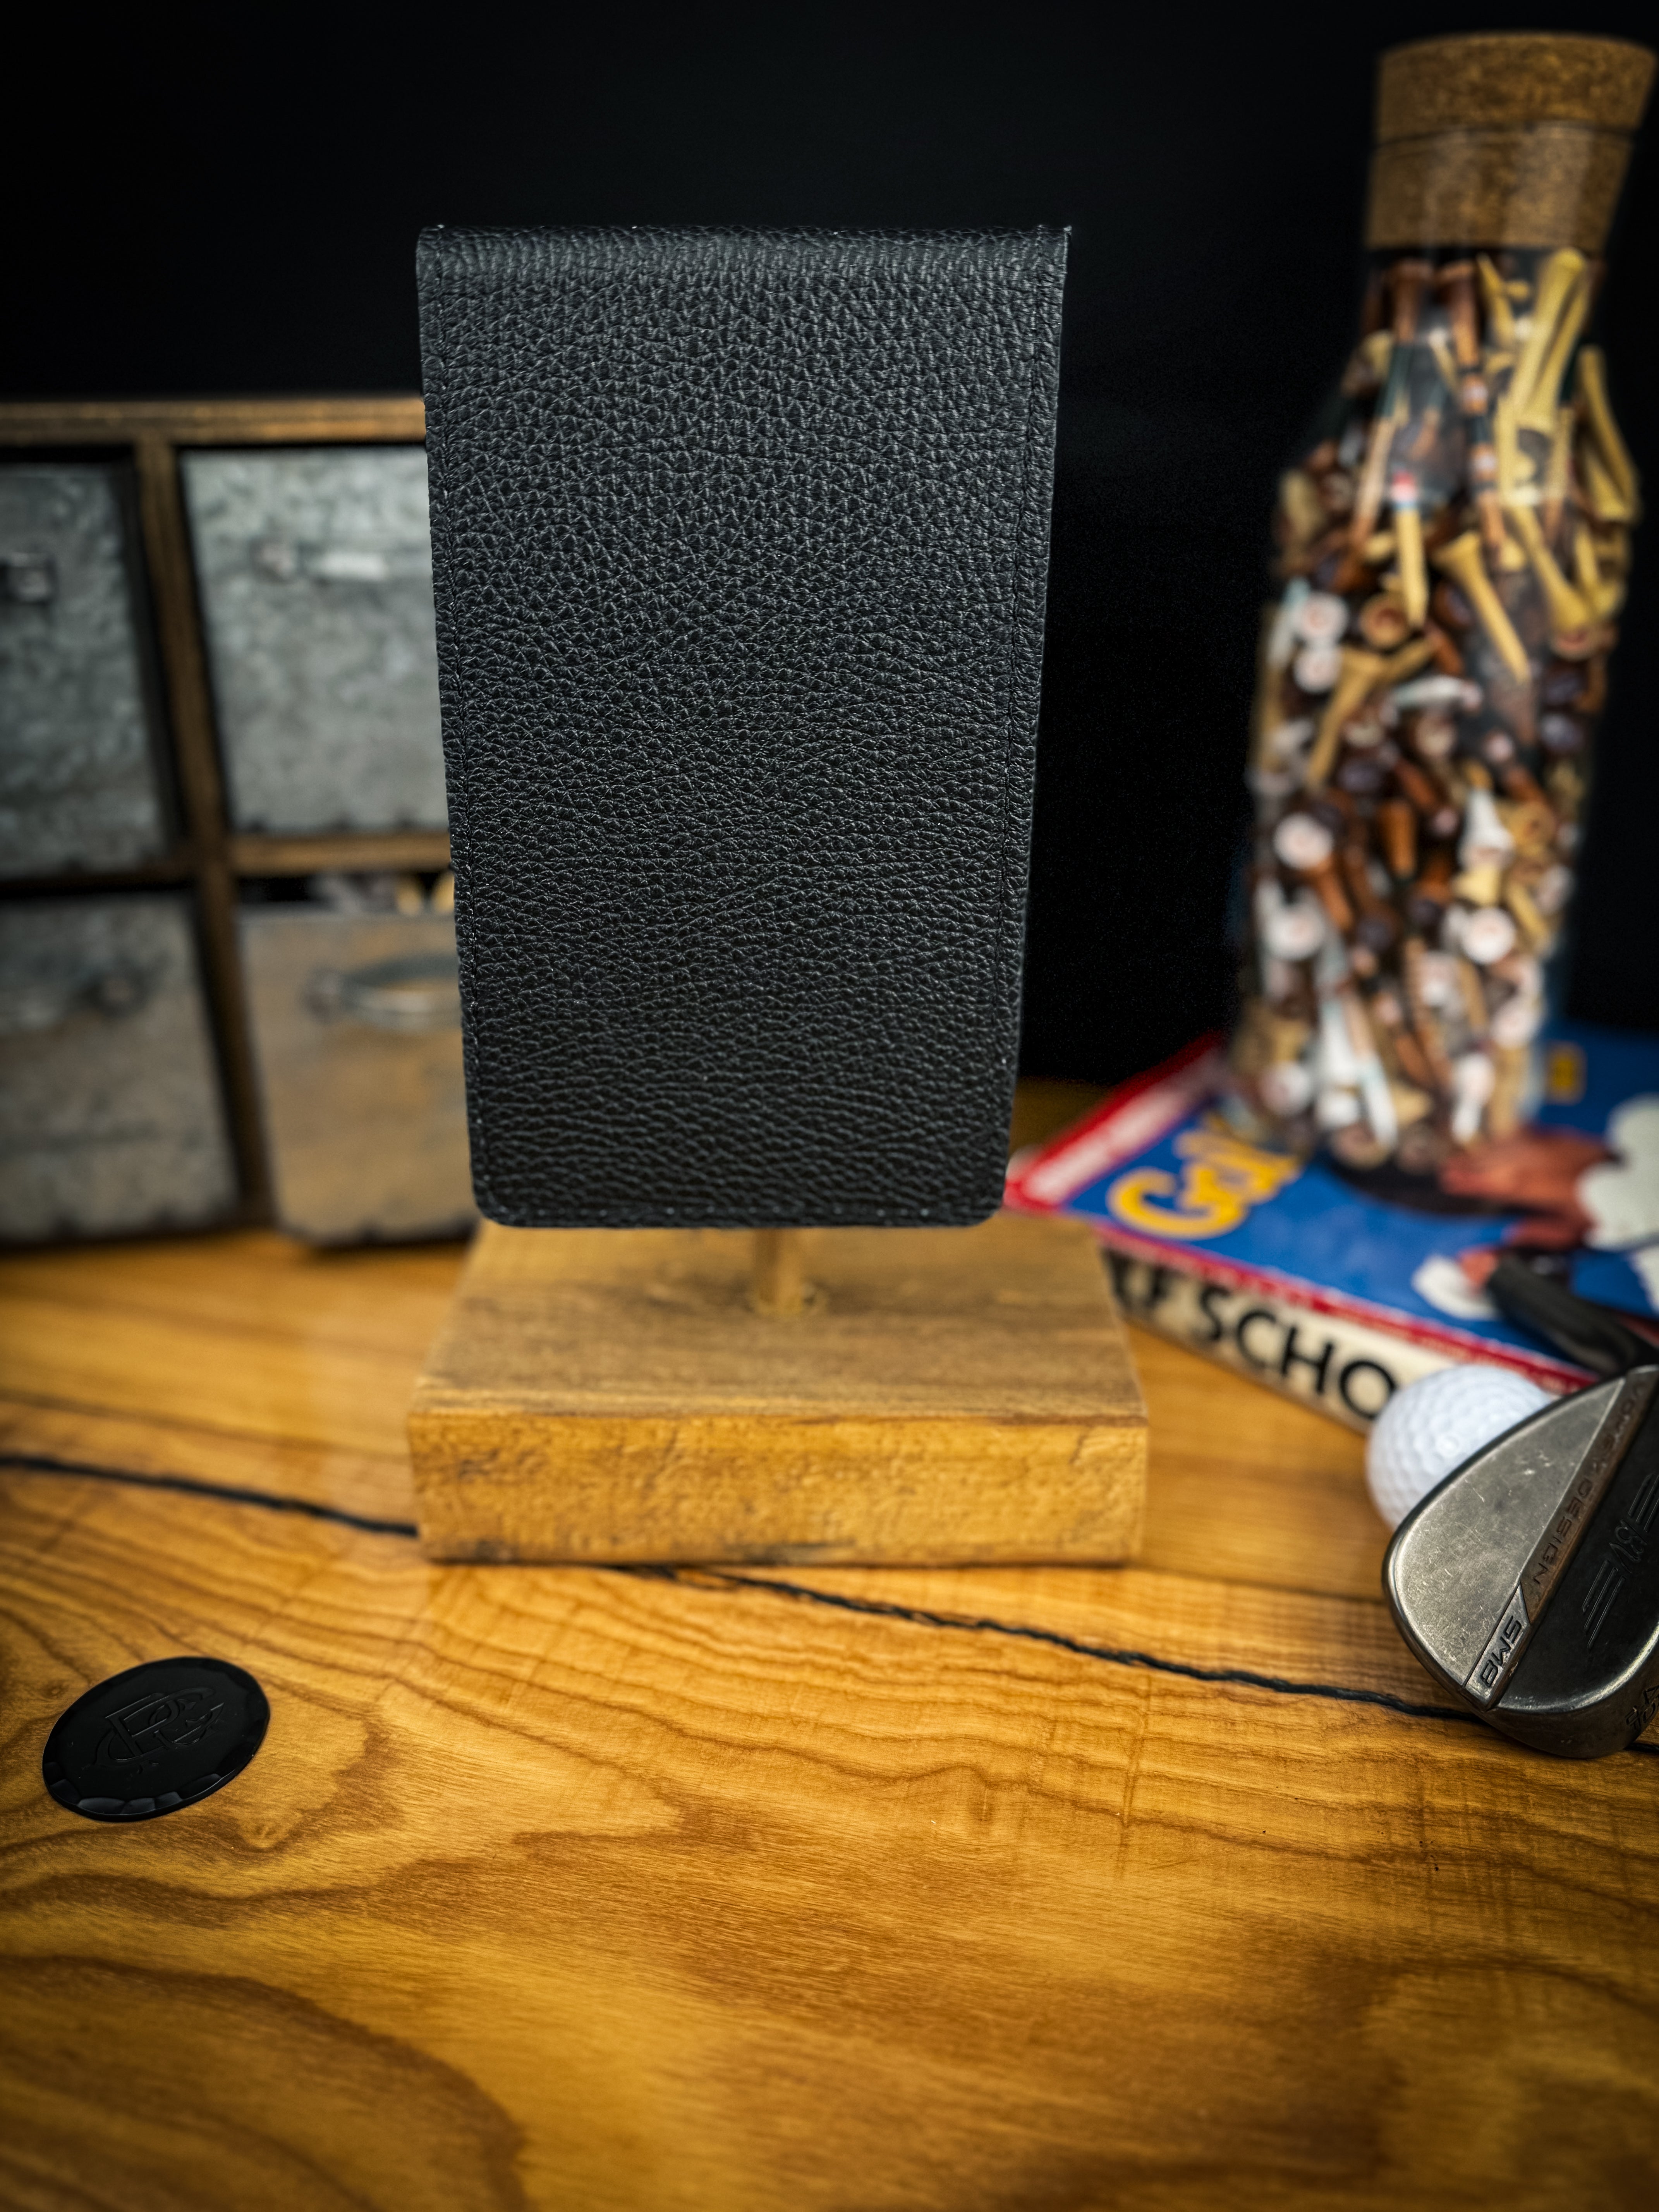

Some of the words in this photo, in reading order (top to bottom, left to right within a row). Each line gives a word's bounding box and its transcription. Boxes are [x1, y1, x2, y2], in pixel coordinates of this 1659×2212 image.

[1195, 1282, 1396, 1420] SCHO
[1532, 1477, 1592, 1585] DESIGN
[1479, 1615, 1522, 1688] SM8
